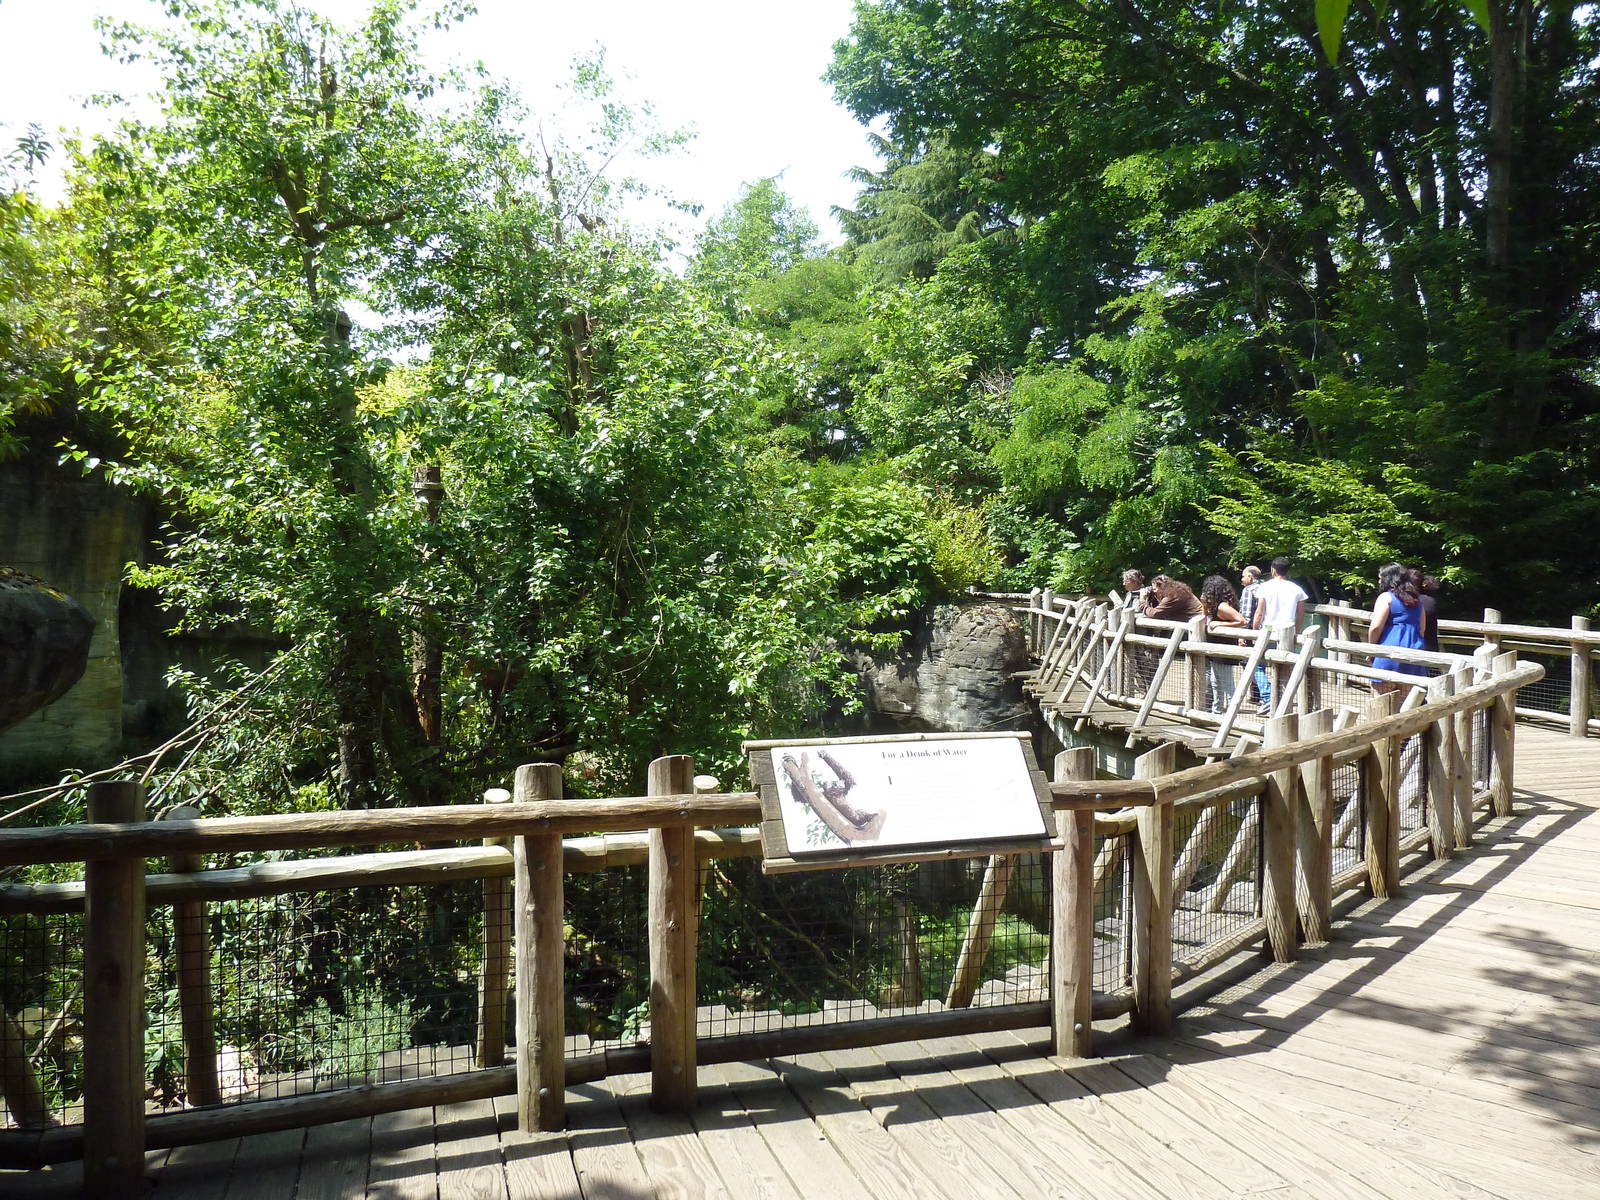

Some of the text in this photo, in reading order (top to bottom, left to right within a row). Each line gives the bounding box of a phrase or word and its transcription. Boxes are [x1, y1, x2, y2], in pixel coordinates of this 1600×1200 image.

[882, 751, 896, 759] For
[932, 749, 941, 757] of
[942, 748, 968, 756] Water
